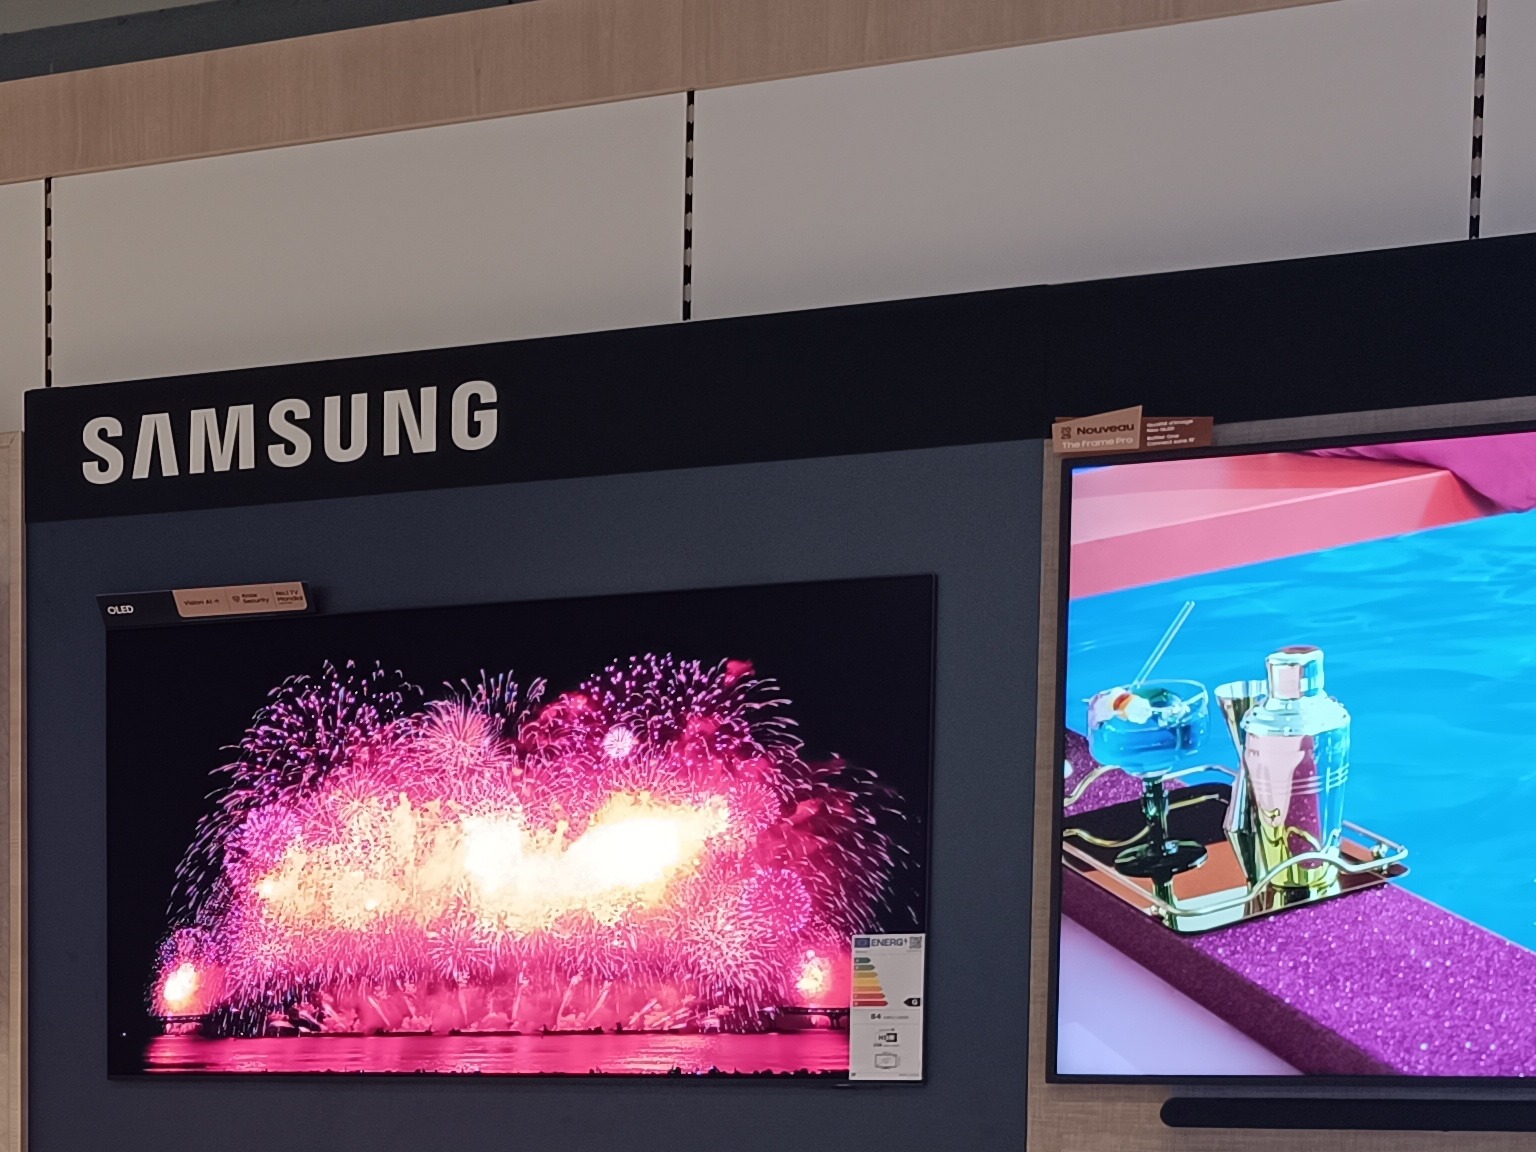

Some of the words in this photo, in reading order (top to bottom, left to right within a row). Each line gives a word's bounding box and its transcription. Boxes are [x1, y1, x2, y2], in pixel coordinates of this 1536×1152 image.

[82, 380, 499, 484] SAMSUNG
[1077, 424, 1134, 435] Nouveau
[1062, 441, 1080, 449] The
[1081, 439, 1115, 447] Frame
[107, 605, 134, 615] OLED
